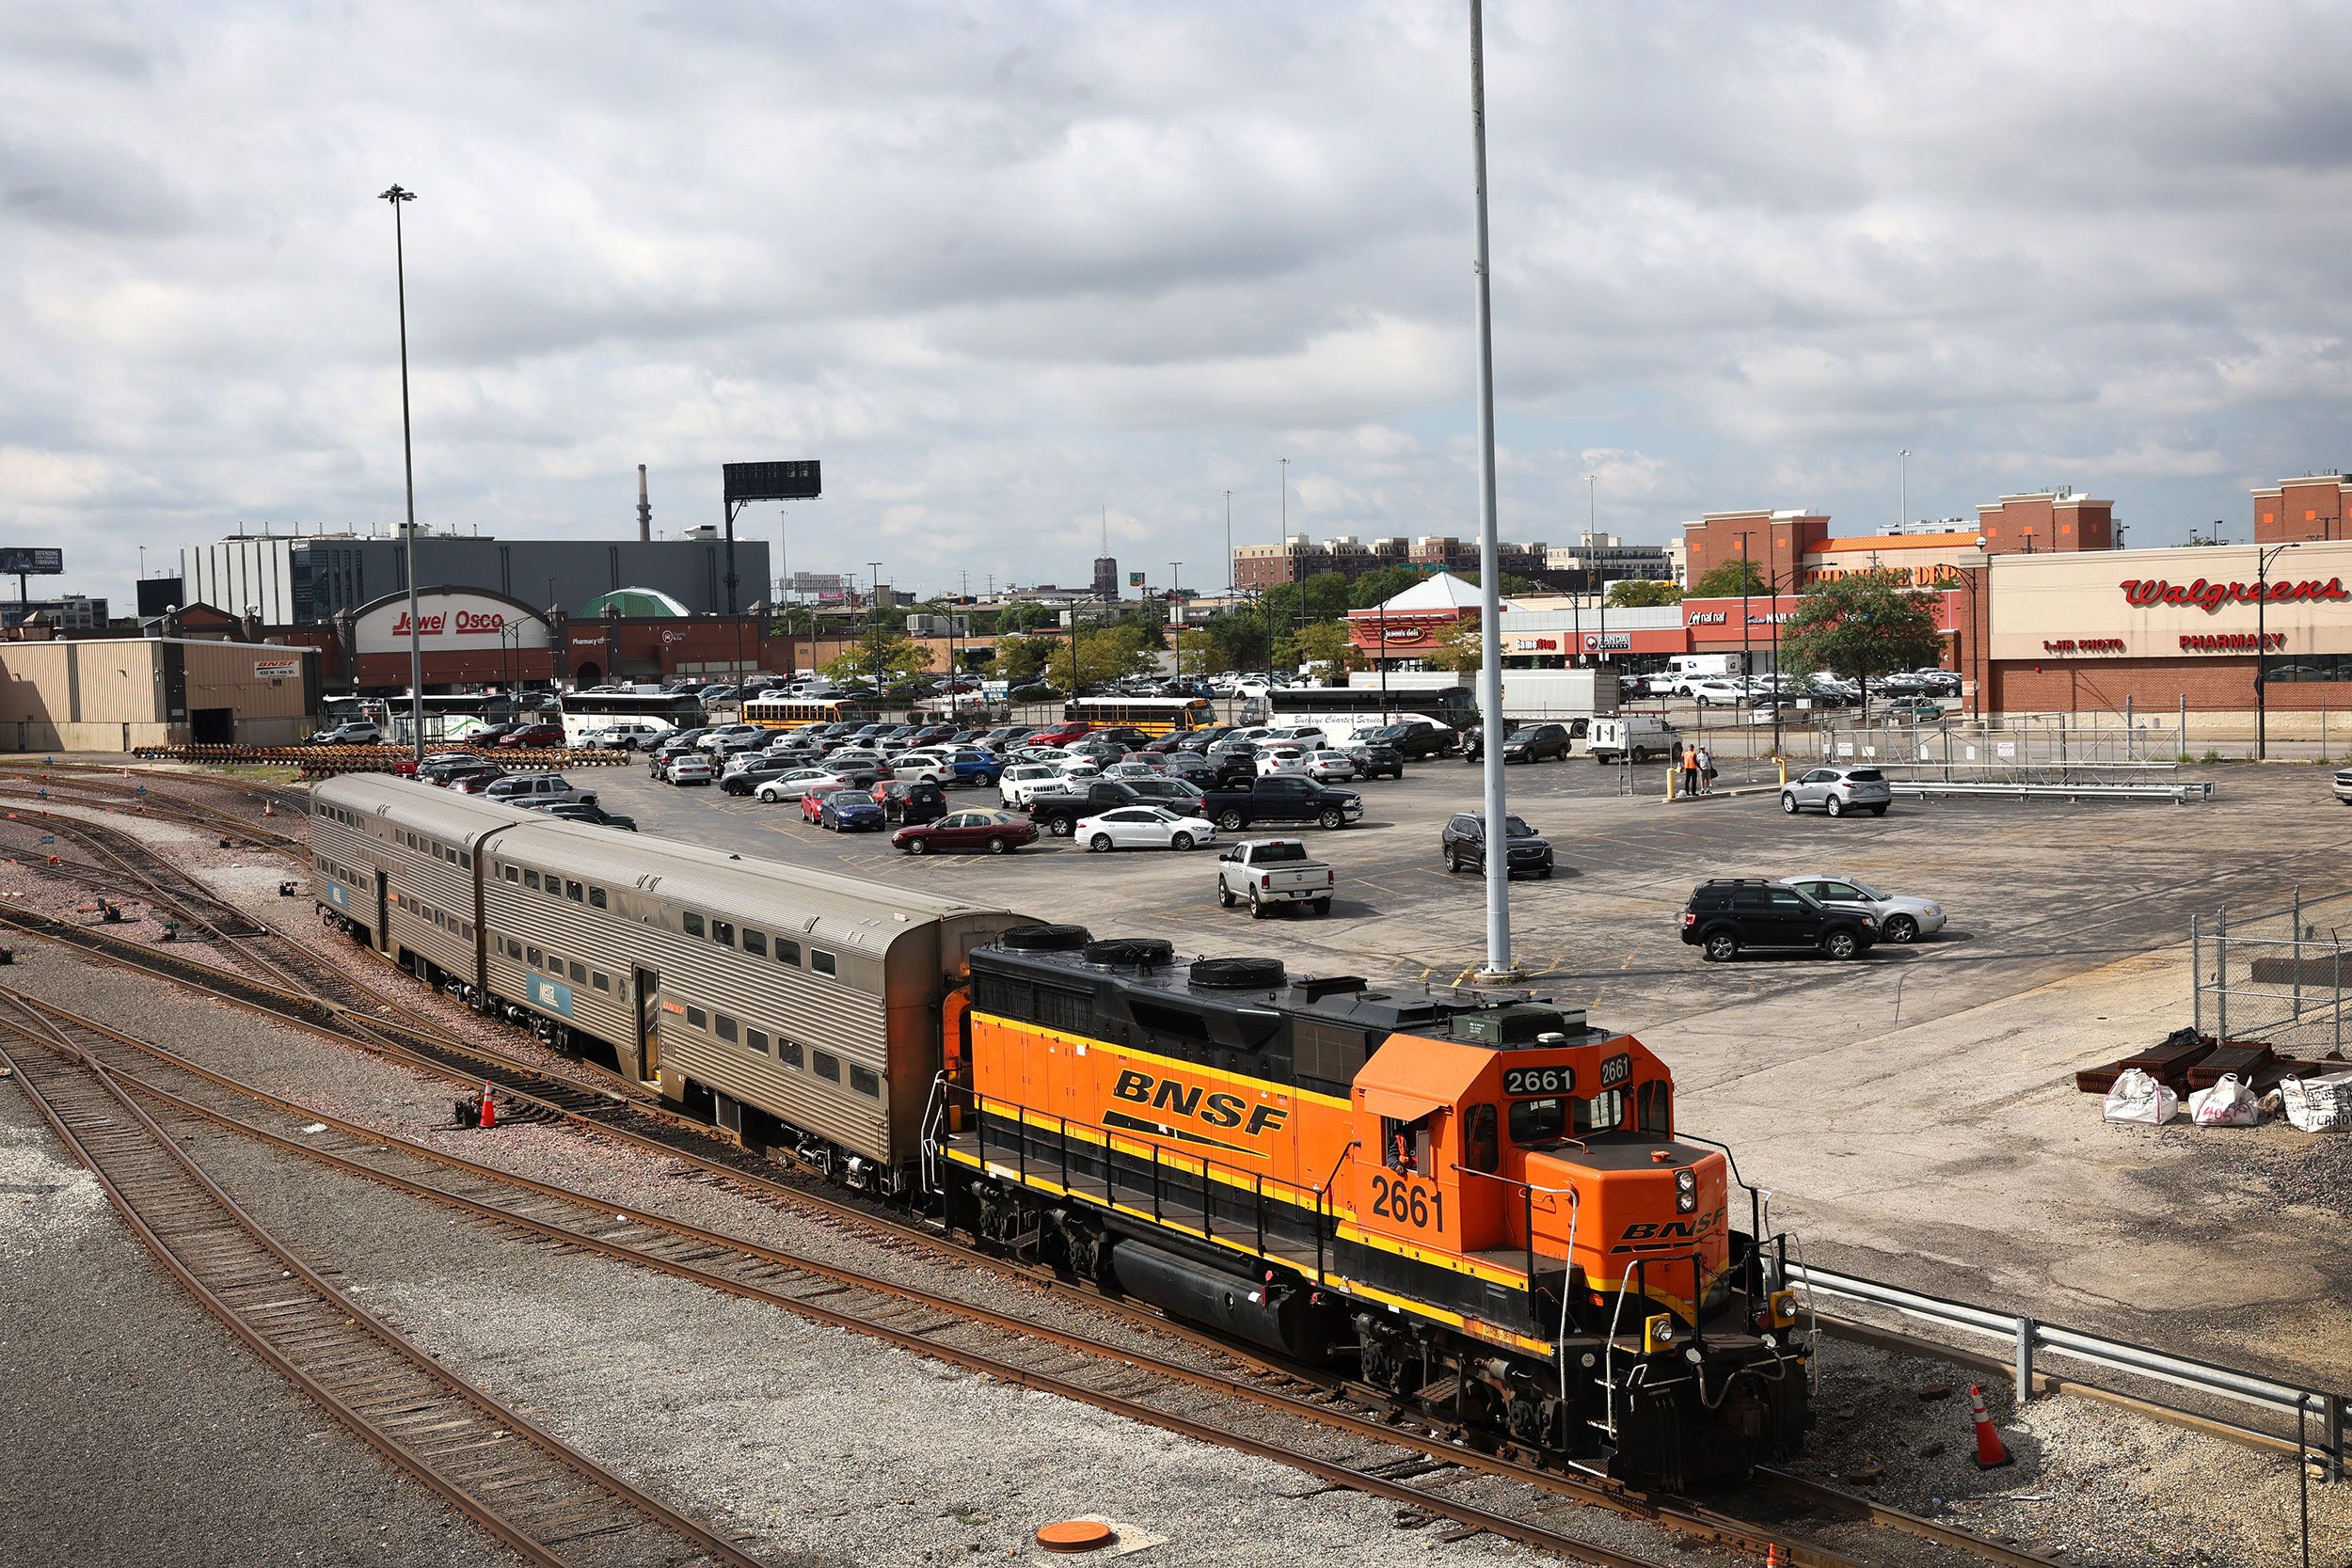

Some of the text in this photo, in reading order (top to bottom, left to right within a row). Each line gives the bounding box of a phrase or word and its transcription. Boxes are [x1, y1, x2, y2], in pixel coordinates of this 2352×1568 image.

[1914, 566, 1961, 585] DEP
[2120, 578, 2349, 610] Walgreens
[455, 610, 503, 629] Osco
[1701, 611, 1725, 622] naf naf
[1406, 628, 1419, 637] deli
[1599, 636, 1628, 644] PANDA
[2179, 633, 2282, 649] PHARMACY
[1516, 639, 1556, 649] GameStop
[2042, 639, 2122, 650] 1-HR PHOTO
[1294, 715, 1323, 724] Buckeye
[1325, 715, 1354, 723] Charter
[1356, 715, 1384, 723] Service
[539, 982, 555, 1001] Metra
[662, 1000, 685, 1014] BNSF
[1602, 1056, 1629, 1085] 2661
[1508, 1069, 1572, 1093] 2661
[1112, 1069, 1289, 1136] BNSF
[1372, 1175, 1443, 1233] 2661
[1618, 1205, 1726, 1241] BNSF
